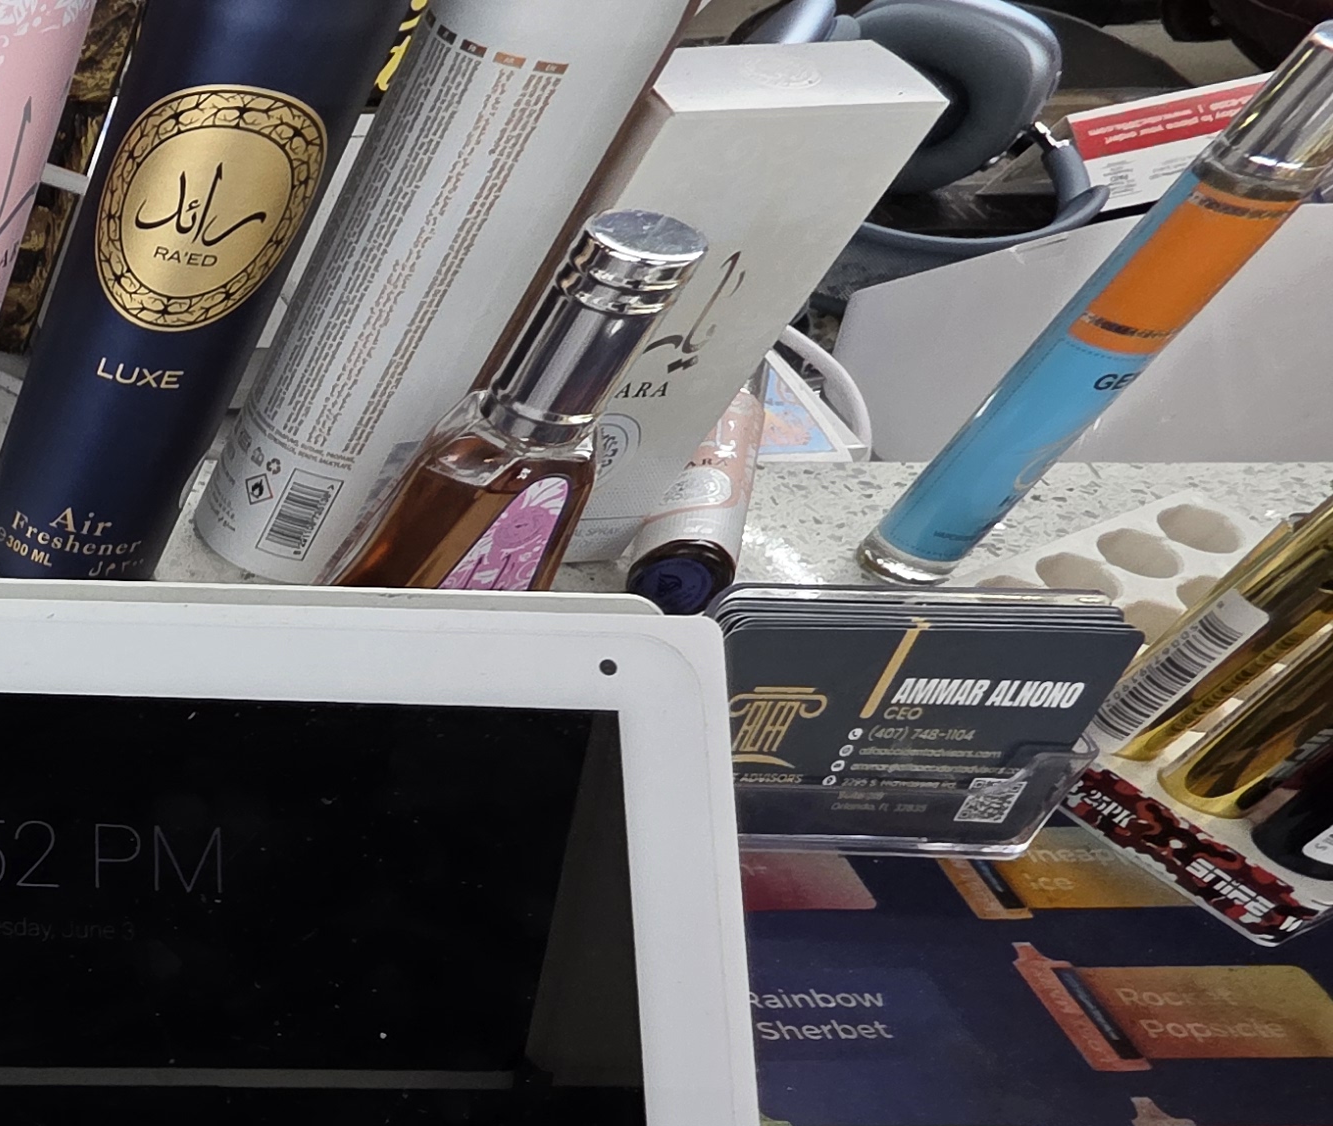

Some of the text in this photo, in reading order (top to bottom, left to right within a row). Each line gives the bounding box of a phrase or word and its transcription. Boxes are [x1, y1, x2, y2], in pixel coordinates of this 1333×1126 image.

[151, 245, 219, 269] RA'ED
[96, 356, 185, 390] LUXE
[614, 381, 670, 399] ARA
[11, 510, 142, 556] Freshener
[49, 507, 113, 537] Air
[5, 534, 53, 568] 300 ML
[890, 678, 991, 706] AMMAR
[883, 707, 923, 721] CEO
[868, 725, 909, 742] (407)
[739, 773, 805, 785] ADVISORS
[94, 822, 224, 894] PM
[62, 920, 116, 941] June
[756, 1019, 894, 1040] Sherbet
